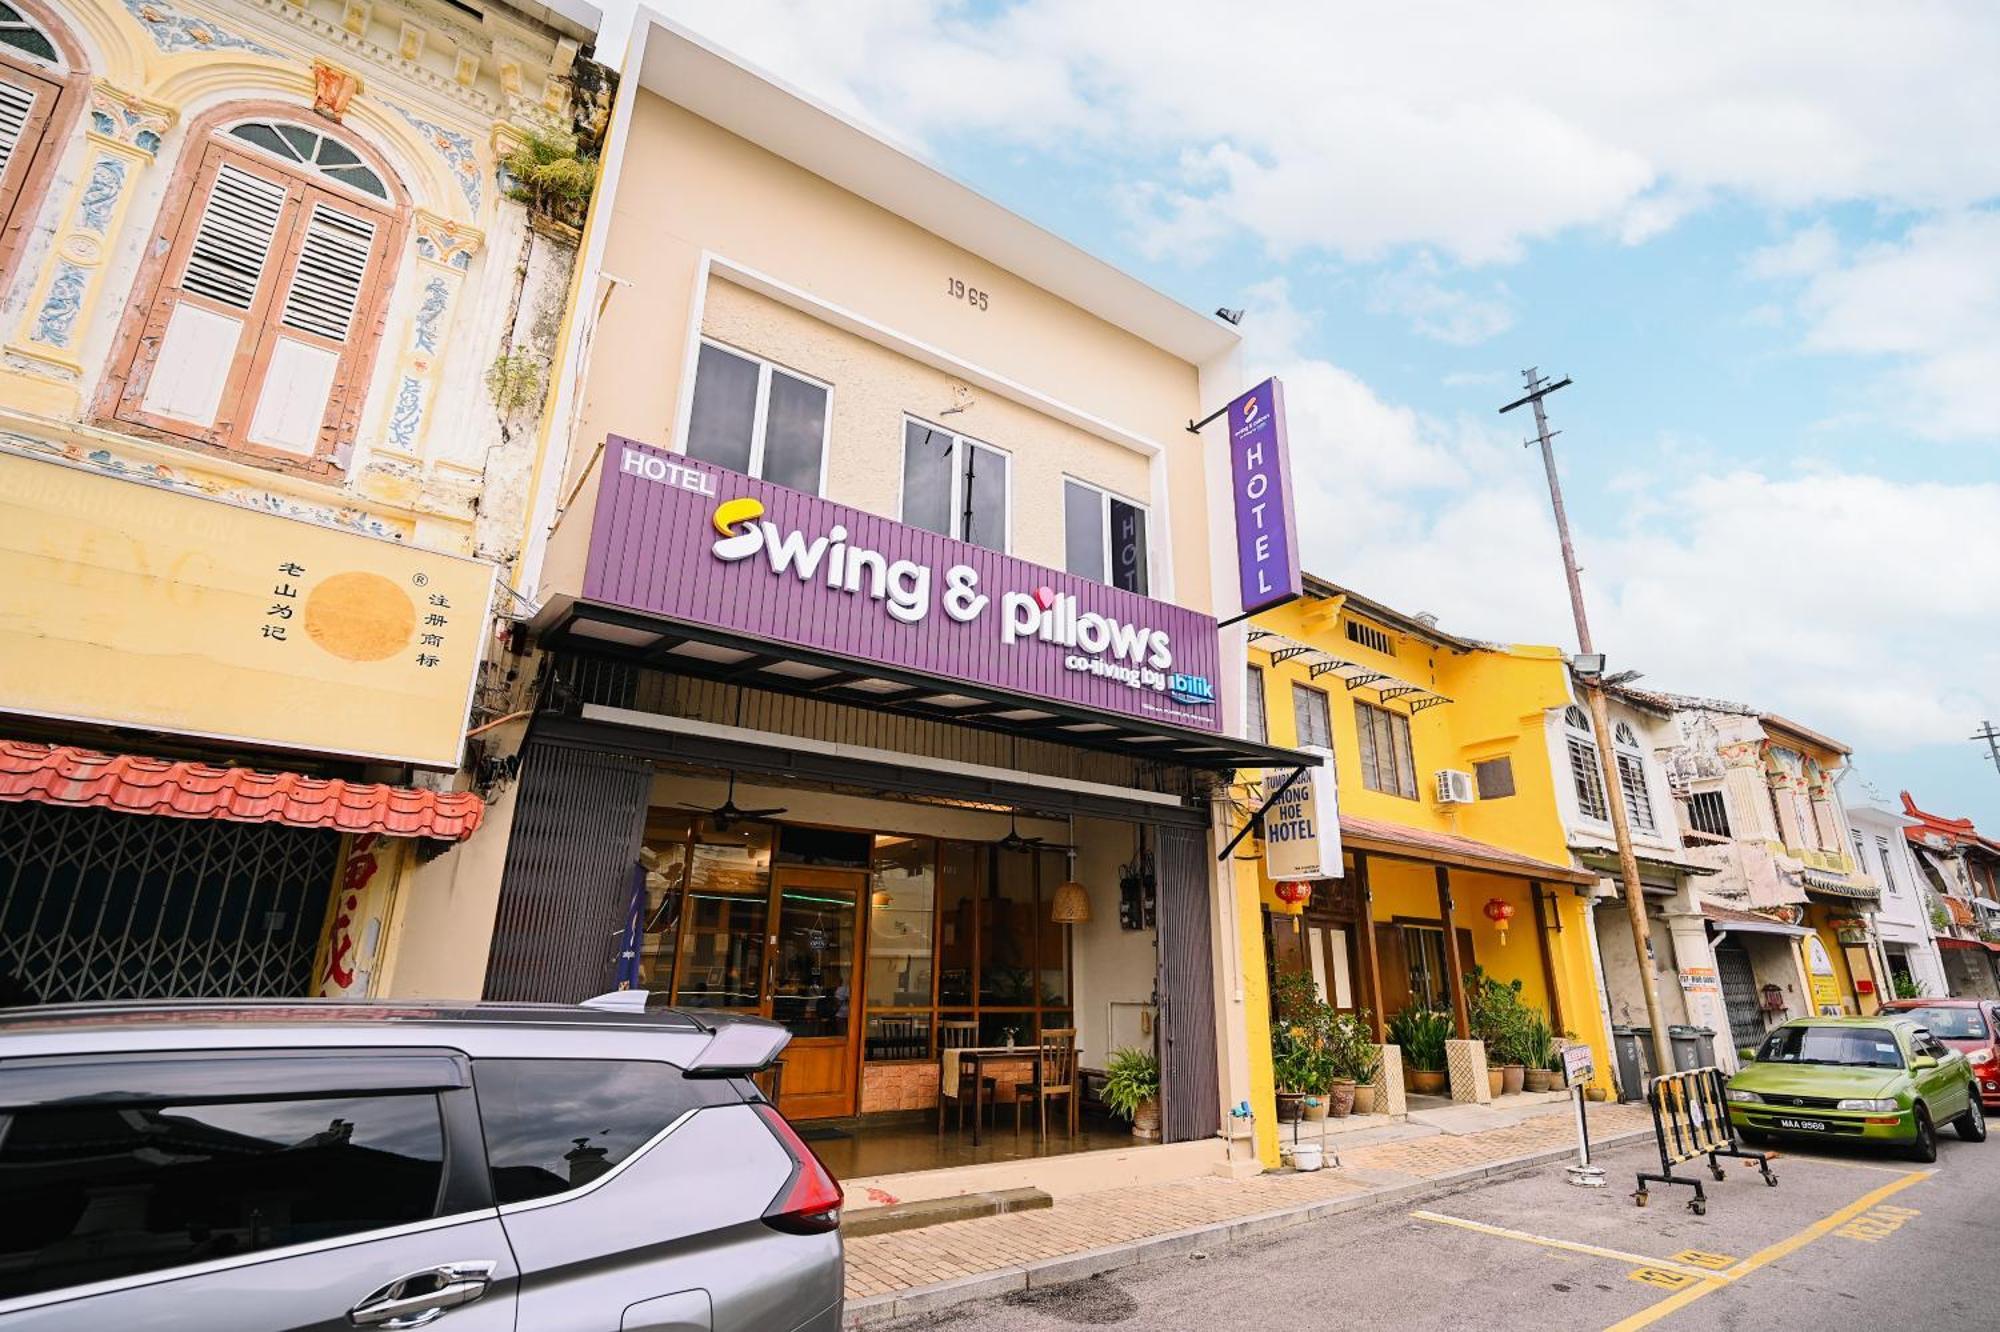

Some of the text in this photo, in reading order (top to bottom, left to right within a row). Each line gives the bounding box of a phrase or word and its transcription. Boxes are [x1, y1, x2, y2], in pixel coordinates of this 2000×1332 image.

[947, 277, 989, 312] 1965
[622, 449, 717, 499] HOTEL
[1246, 441, 1273, 595] HOTEL
[261, 562, 306, 641] 老山为记
[712, 497, 1173, 672] Swing & pillows
[416, 593, 451, 668] 注册商标
[1065, 655, 1141, 689] co-living
[1141, 667, 1166, 692] by
[1272, 786, 1309, 806] HONG
[1279, 803, 1302, 821] HOE
[1269, 820, 1316, 843] HOTEL
[1780, 1119, 1801, 1129] MAA
